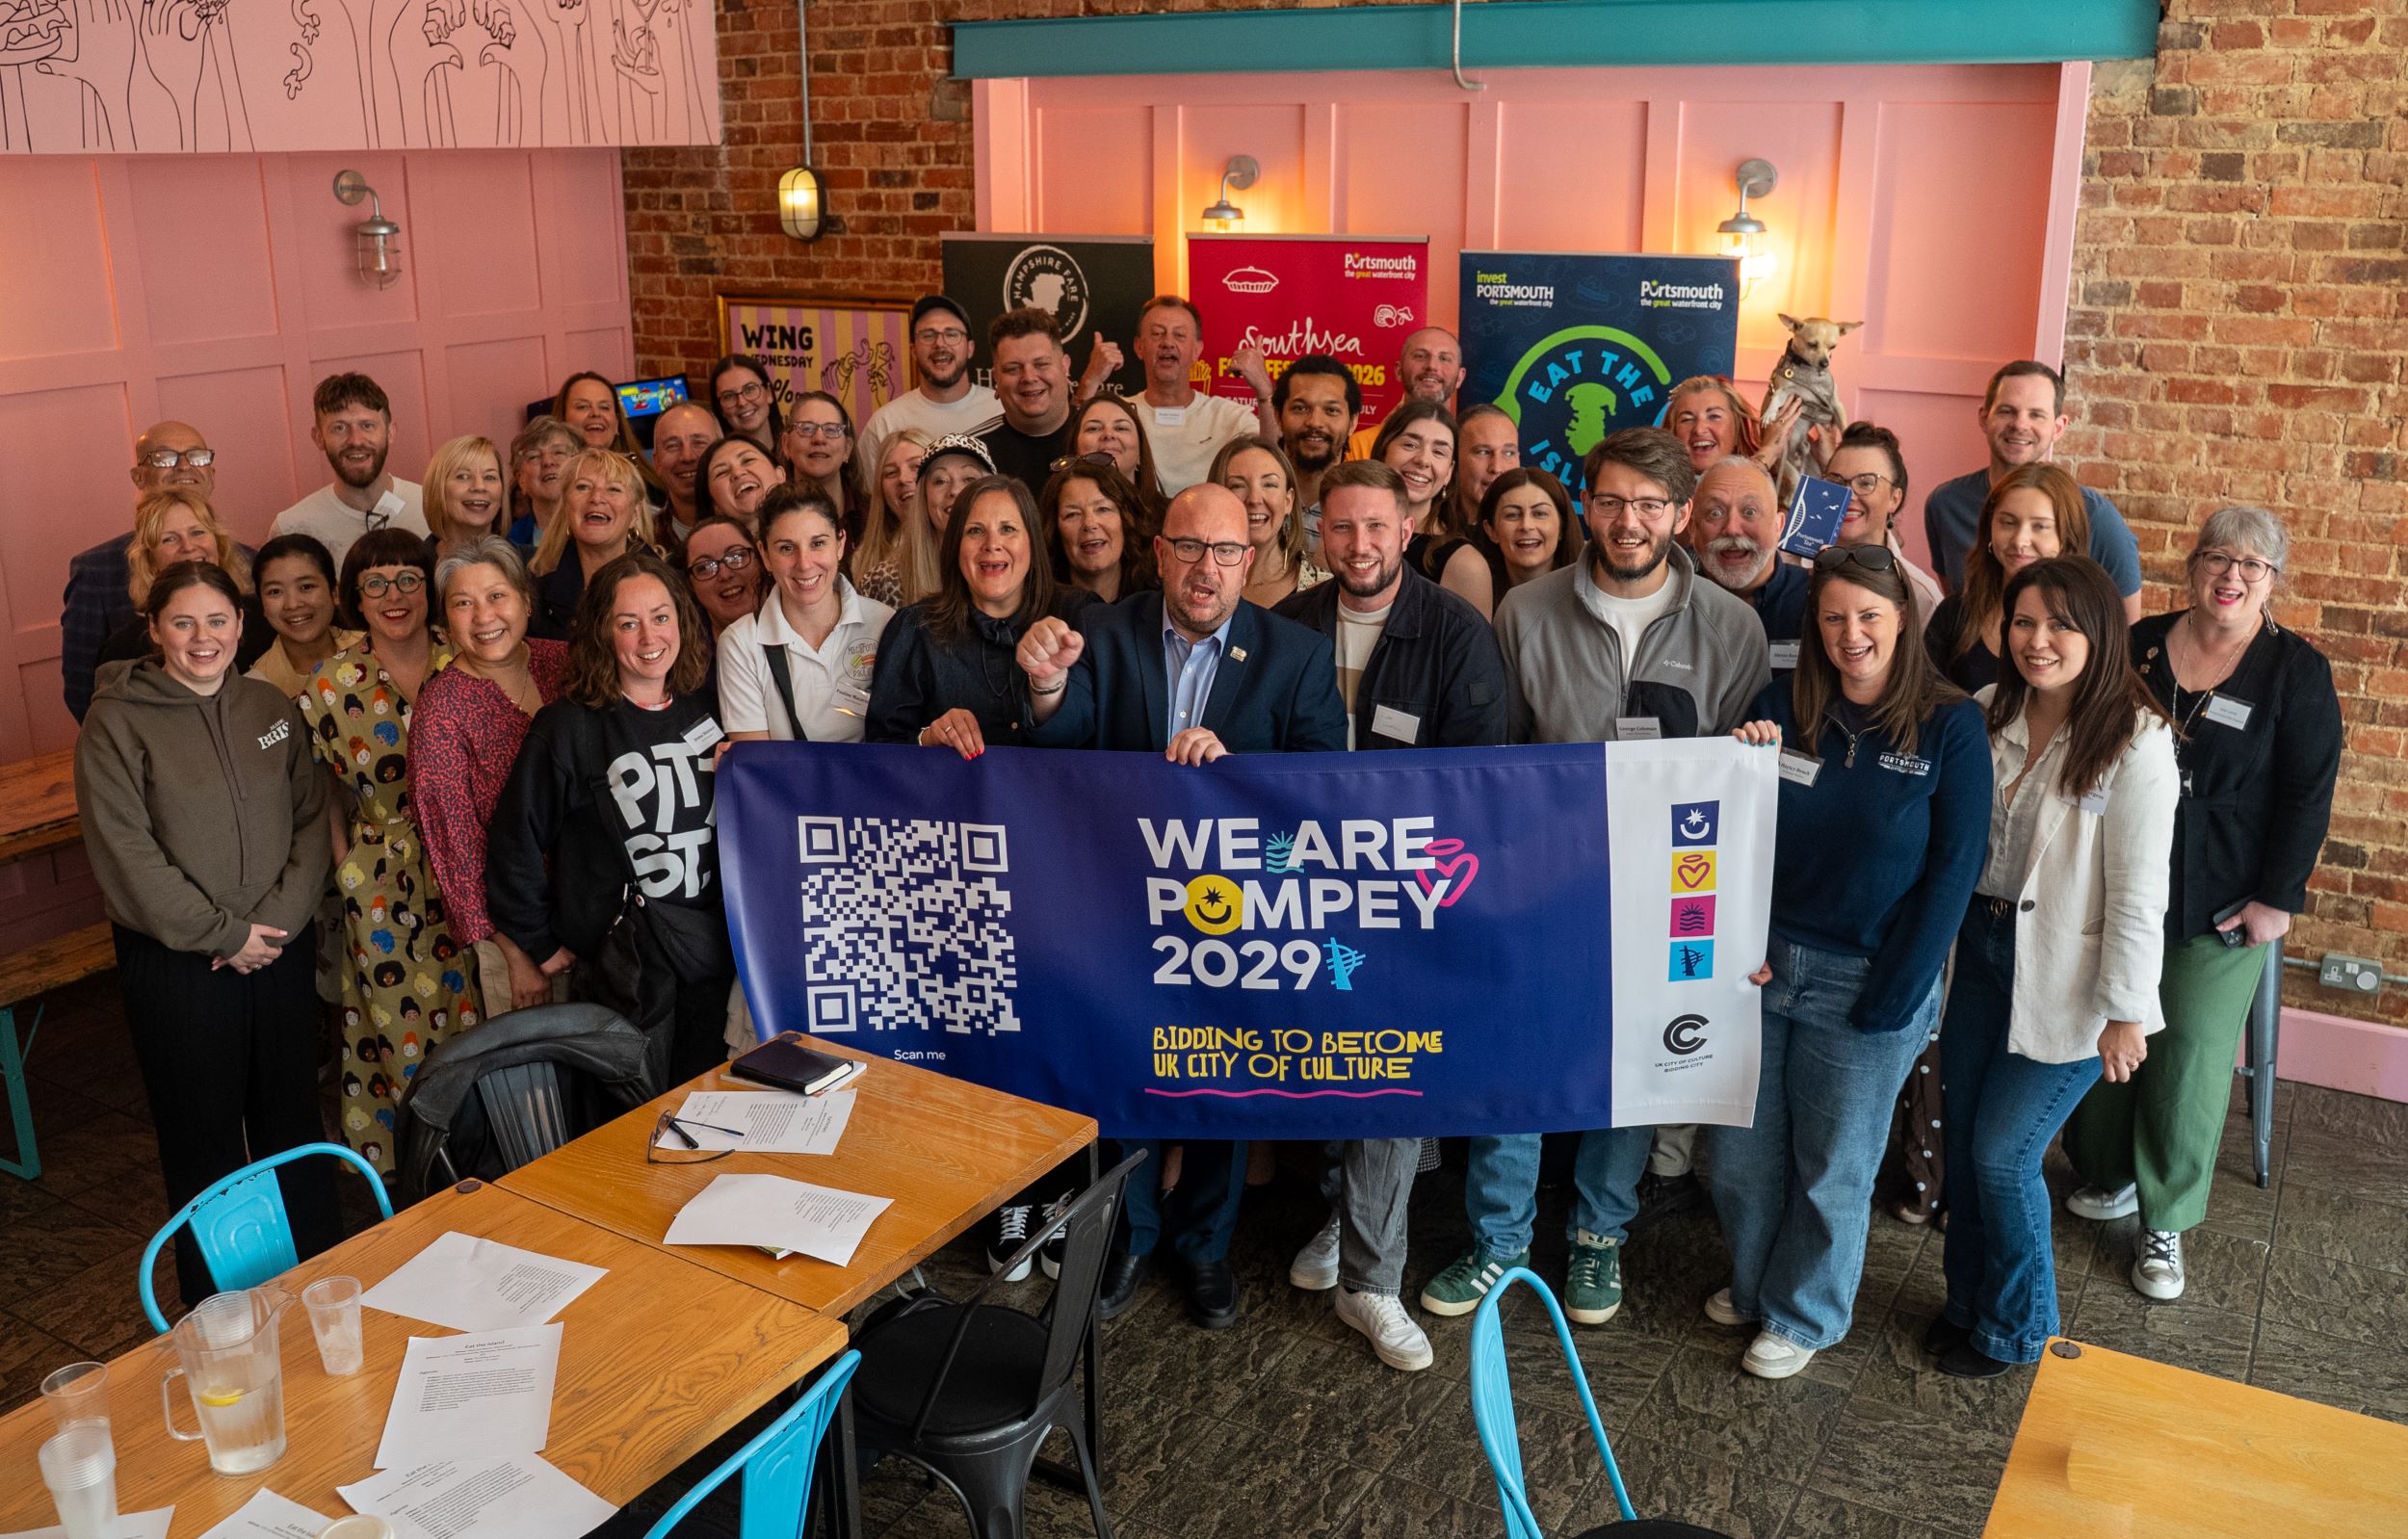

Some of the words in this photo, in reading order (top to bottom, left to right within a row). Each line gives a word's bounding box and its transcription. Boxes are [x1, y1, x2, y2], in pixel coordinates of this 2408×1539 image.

[1345, 252, 1416, 271] Portsmouth
[1013, 255, 1062, 300] HAMPSHIRE
[1062, 269, 1079, 302] FARE
[1355, 271, 1372, 279] great
[1372, 271, 1403, 279] waterfront
[1403, 273, 1416, 281] city
[1477, 270, 1507, 283] invest
[1477, 284, 1555, 300] PORTSMOUTH
[1640, 279, 1723, 300] Portsmouth
[1640, 298, 1652, 306] the
[1652, 300, 1671, 308] great
[1671, 300, 1708, 309] waterfront
[1709, 300, 1722, 311] city
[741, 324, 813, 351] WING
[749, 353, 813, 368] EDNESDAY
[1528, 350, 1584, 404] EAT
[1600, 350, 1655, 408] THE
[1879, 754, 1930, 771] PORTSMOUTH
[1138, 817, 1262, 871] WE
[1287, 816, 1436, 872] ARE
[1146, 874, 1452, 935] POMPEY
[1152, 935, 1322, 990] 2029
[1153, 1026, 1264, 1051] BIDDING
[1270, 1030, 1313, 1053] TO
[1321, 1030, 1443, 1055] BECOME
[894, 1049, 924, 1060] Scan
[927, 1051, 946, 1060] me
[1687, 1054, 1714, 1063] CULTURE
[1153, 1053, 1180, 1079] UK
[1187, 1051, 1240, 1079] CITY
[1247, 1053, 1293, 1082] OF
[1300, 1056, 1413, 1081] CULTURE
[1663, 1064, 1689, 1073] BIDDING
